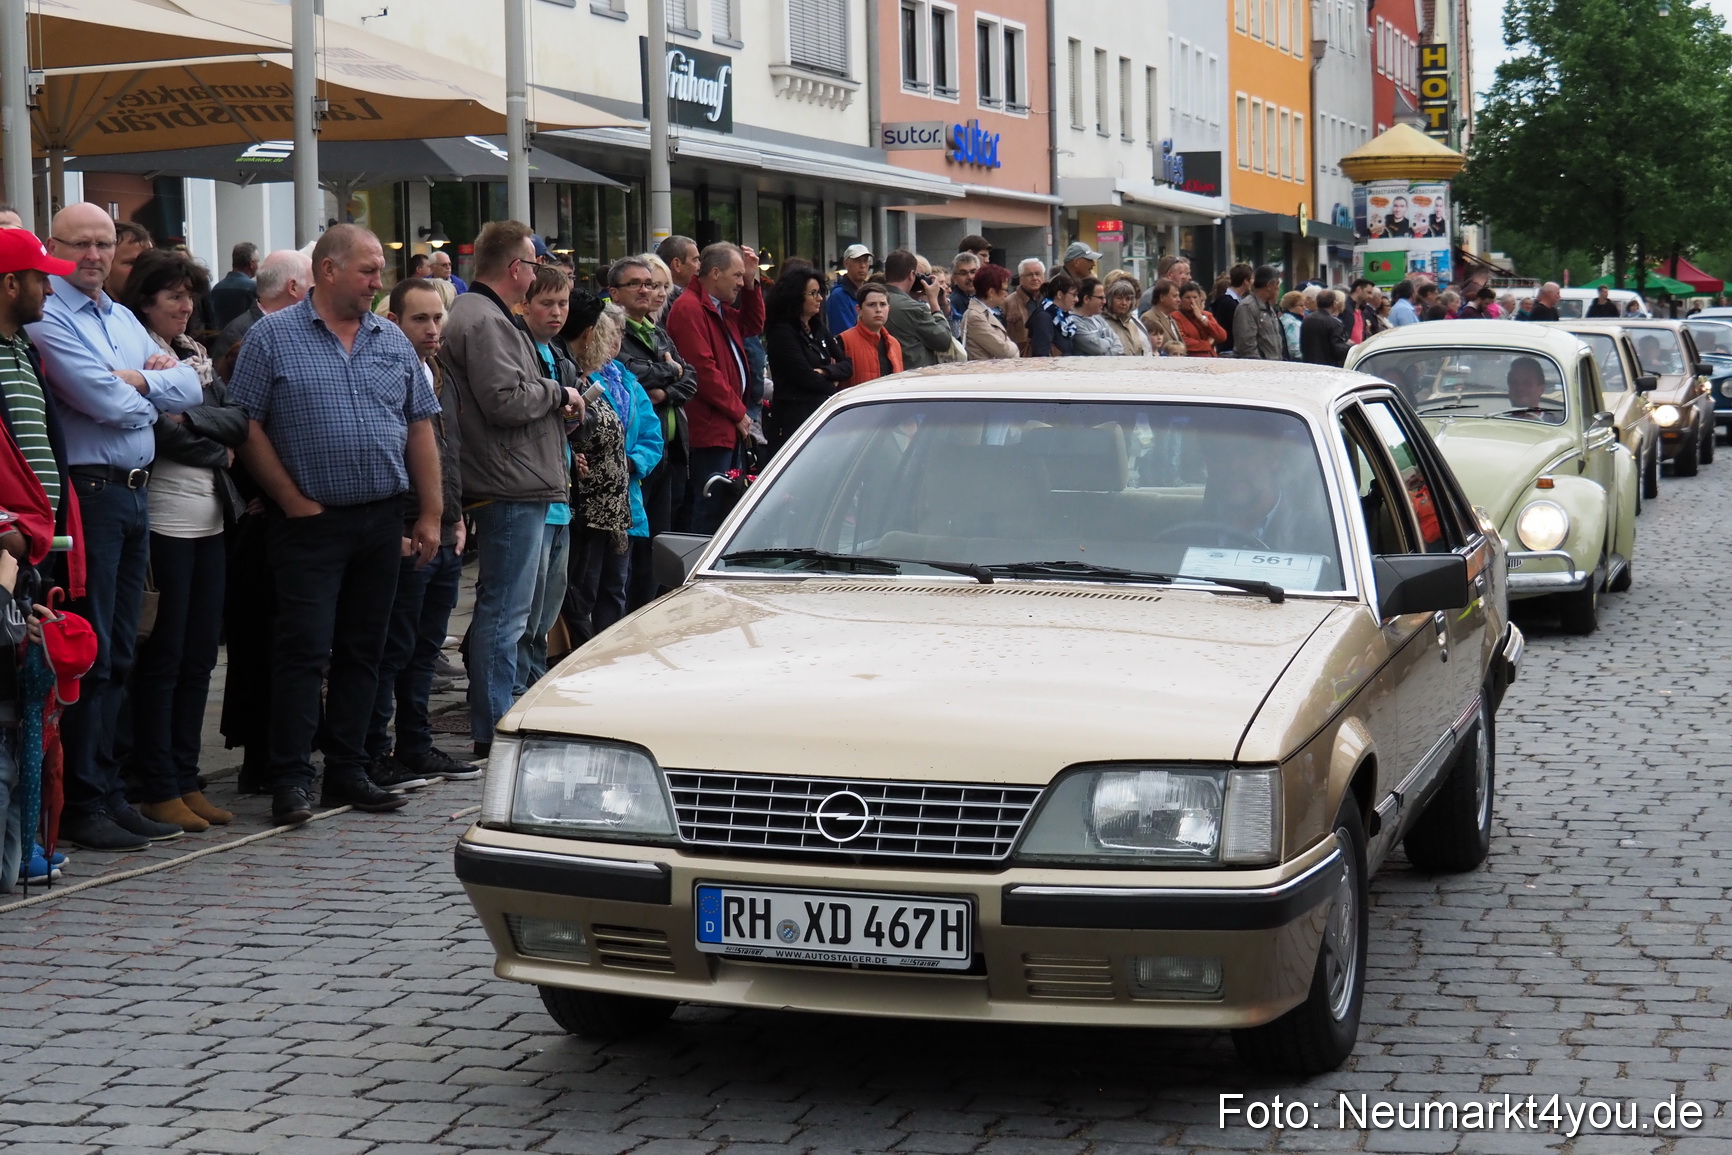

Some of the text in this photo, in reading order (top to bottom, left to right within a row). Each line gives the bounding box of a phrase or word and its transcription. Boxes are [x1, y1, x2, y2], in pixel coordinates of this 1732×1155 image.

[1422, 47, 1448, 144] HOT
[1252, 555, 1294, 567] 561
[705, 920, 715, 933] D
[724, 895, 964, 952] RH XD 467H
[775, 950, 888, 965] WWW.AUTOSTAIGER.DE
